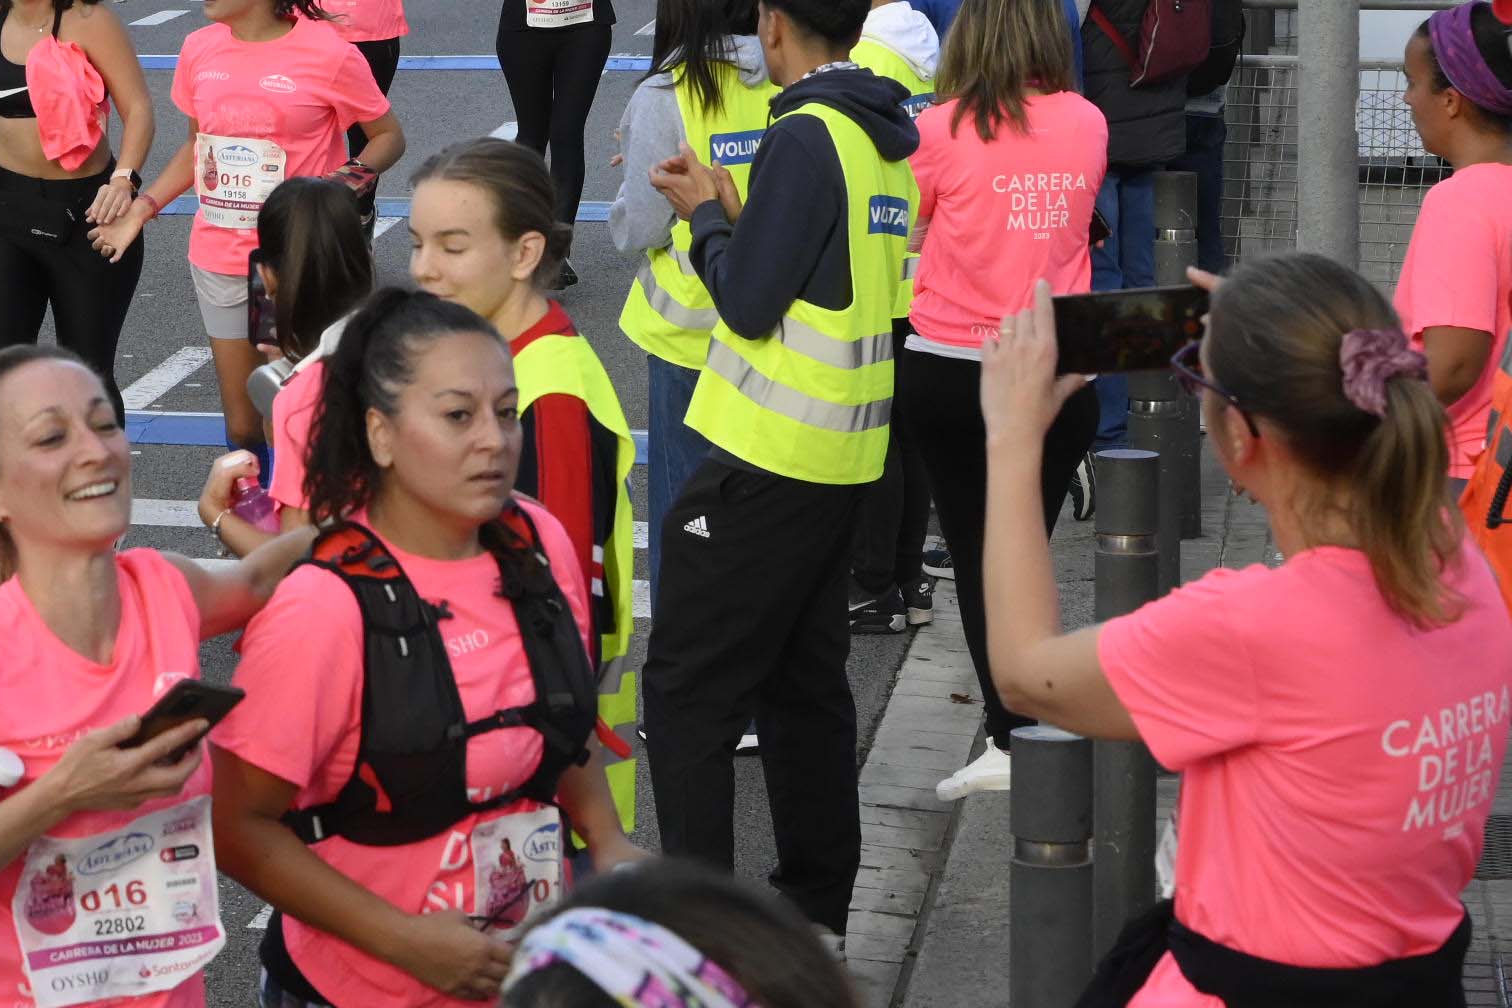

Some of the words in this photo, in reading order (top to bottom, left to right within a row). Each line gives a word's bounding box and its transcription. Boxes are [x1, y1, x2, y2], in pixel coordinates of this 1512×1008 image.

[221, 173, 252, 188] 016
[992, 171, 1087, 193] CARRERA
[223, 190, 247, 200] 19158
[1010, 192, 1038, 213] DE
[1044, 191, 1070, 210] LA
[1006, 209, 1071, 232] MUJER
[683, 524, 711, 539] adidas
[447, 628, 490, 657] SHO
[1380, 684, 1511, 757] CARRERA
[1417, 746, 1459, 793] DE
[1465, 732, 1494, 774] LA
[1401, 769, 1493, 833] MUJER
[80, 880, 148, 912] 016
[94, 915, 146, 937] 22802
[49, 947, 102, 963] CARRERA
[103, 945, 118, 956] DE
[119, 942, 135, 954] LA
[136, 937, 175, 951] MUJER
[51, 968, 110, 993] OYSHO
